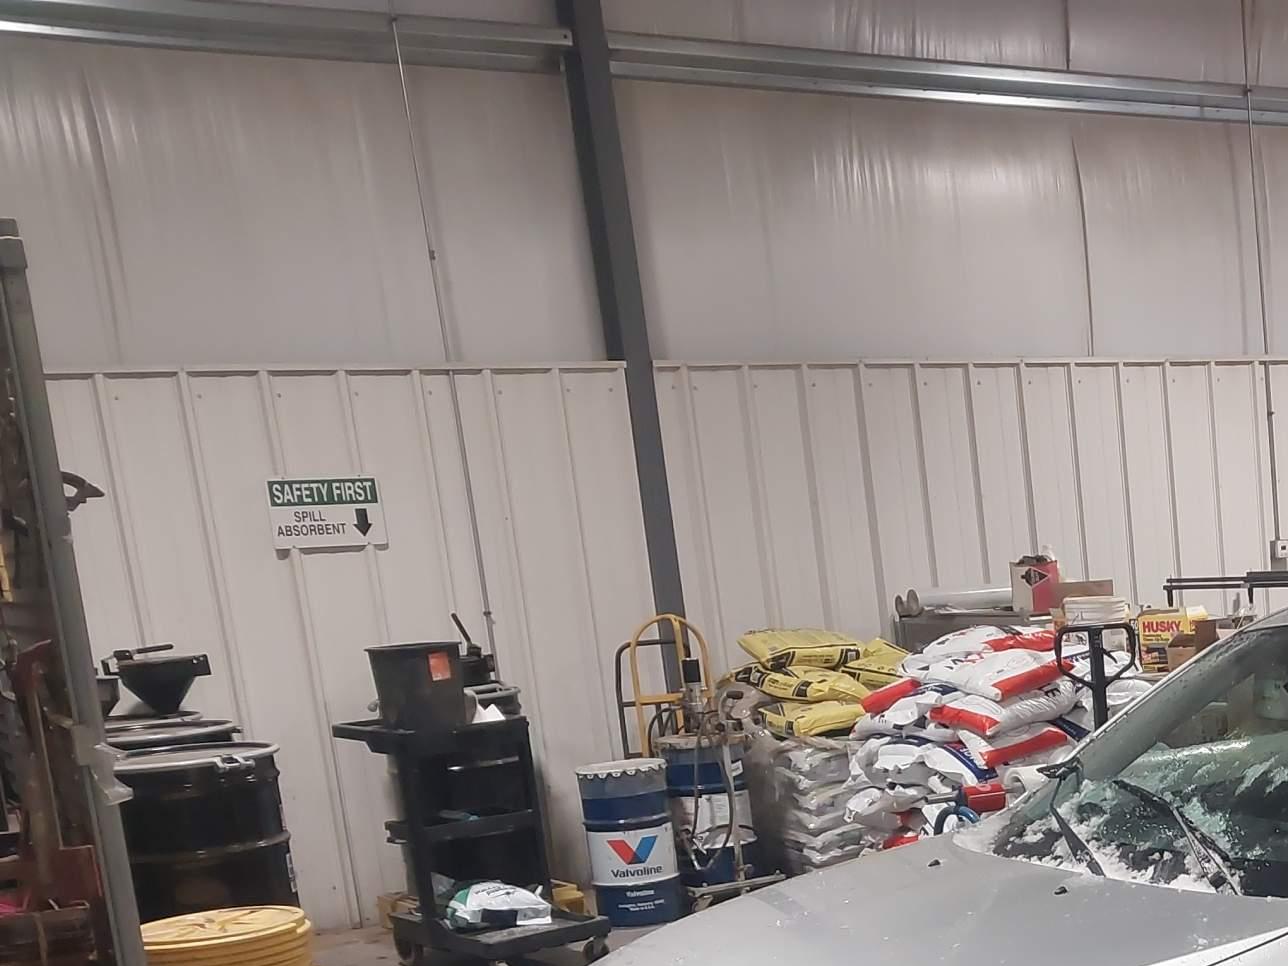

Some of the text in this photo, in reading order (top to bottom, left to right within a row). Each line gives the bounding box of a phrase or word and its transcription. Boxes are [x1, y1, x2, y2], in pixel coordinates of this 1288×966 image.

[272, 481, 372, 504] SAFETY FIRST
[293, 510, 327, 523] SPILL
[277, 523, 346, 537] ABSORBENT
[1142, 620, 1181, 633] HUSKY
[610, 865, 663, 879] Valvoline
